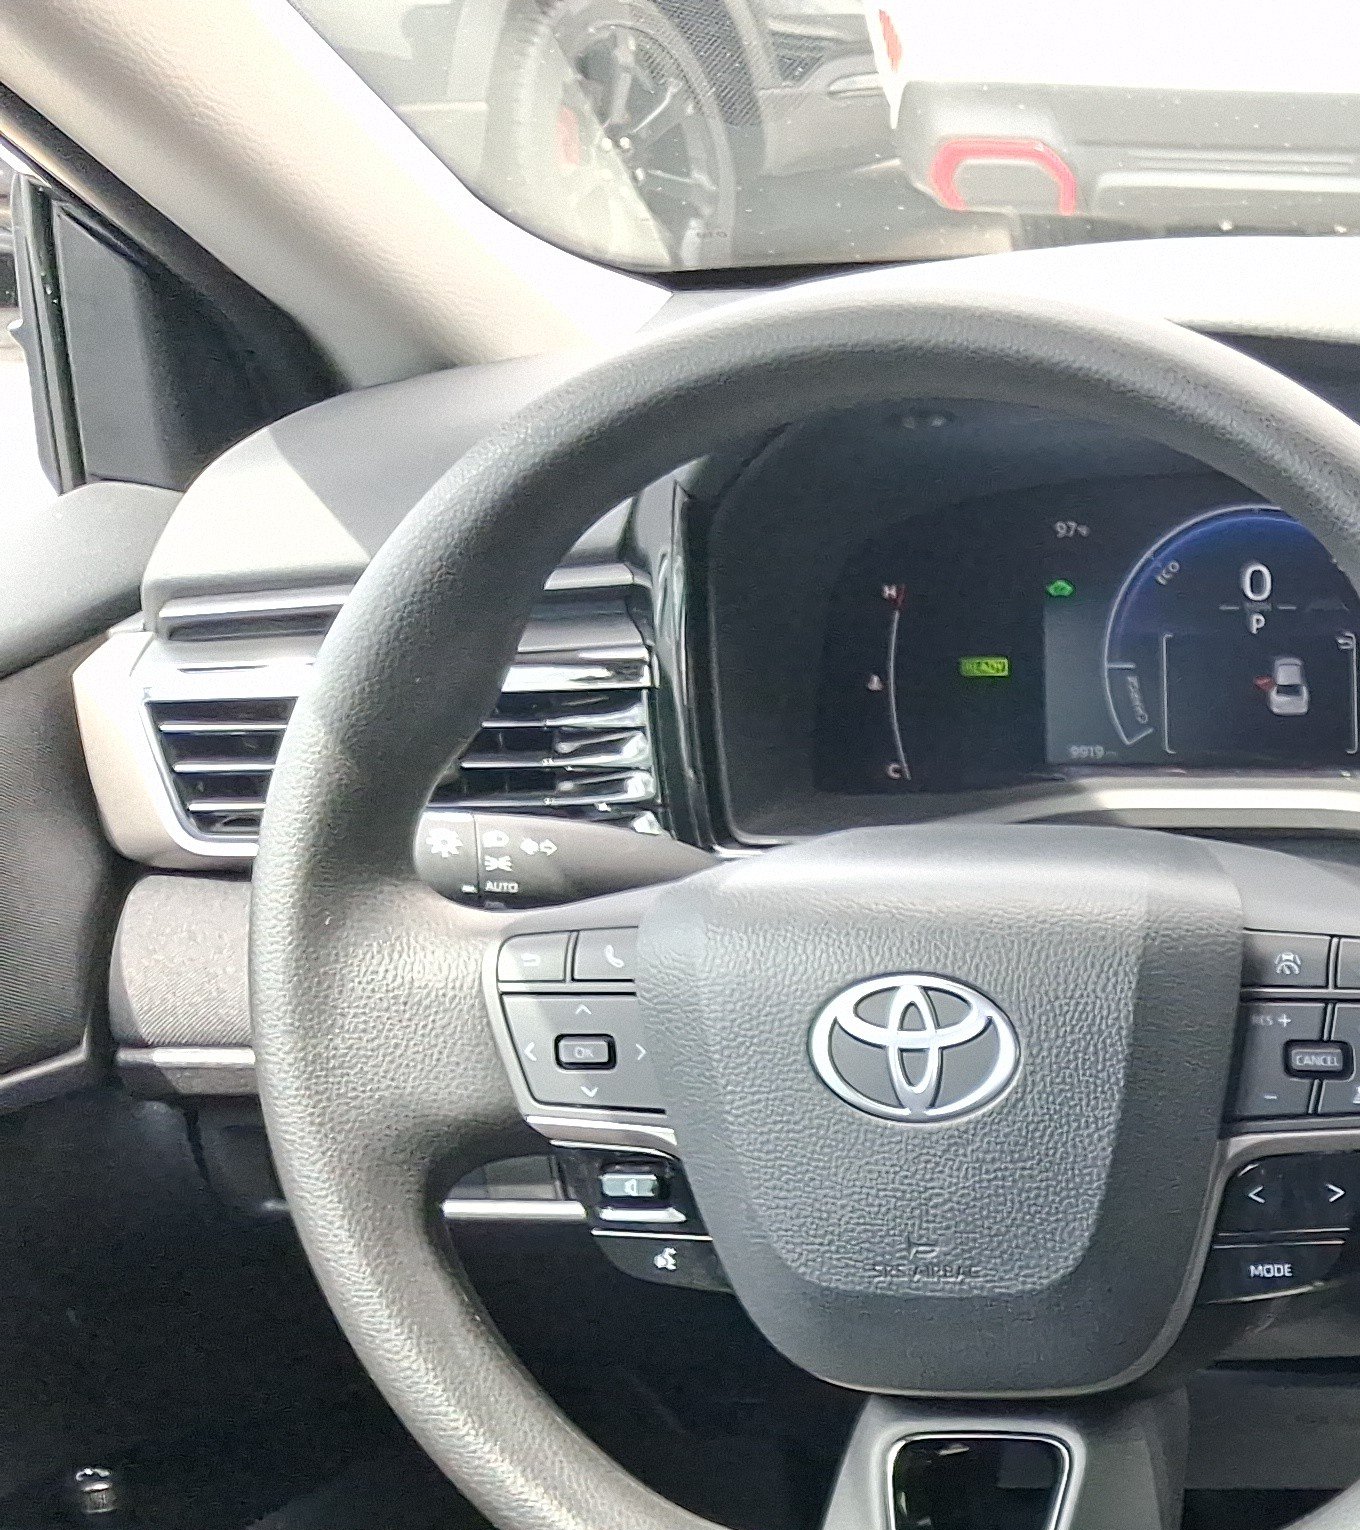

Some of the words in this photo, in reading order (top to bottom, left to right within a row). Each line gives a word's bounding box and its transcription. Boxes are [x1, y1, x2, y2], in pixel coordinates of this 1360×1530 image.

[1243, 562, 1273, 602] 0
[1249, 612, 1266, 635] P
[886, 763, 901, 779] C
[485, 880, 519, 893] AUTO
[1295, 1054, 1340, 1067] CANCEL
[1248, 1261, 1293, 1280] MODE
